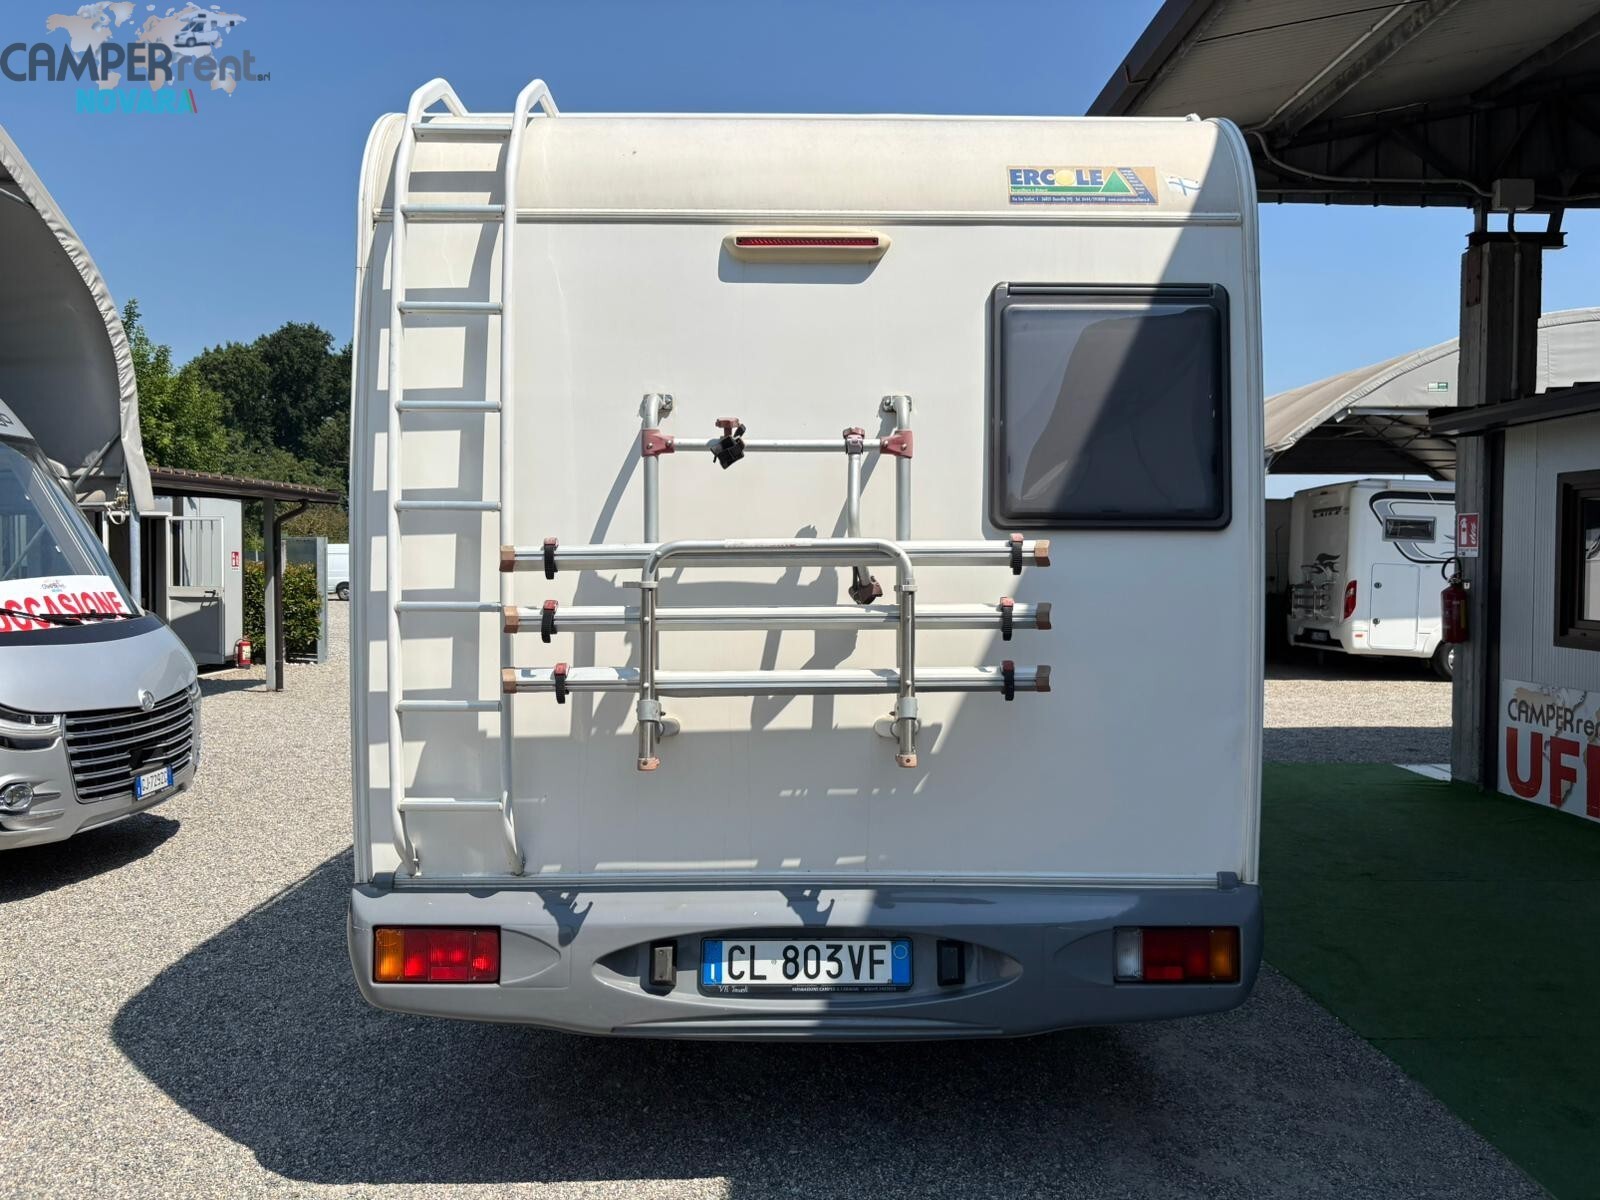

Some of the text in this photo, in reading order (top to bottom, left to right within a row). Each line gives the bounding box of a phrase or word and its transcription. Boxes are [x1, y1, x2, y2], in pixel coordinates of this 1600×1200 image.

[1009, 168, 1104, 186] ERCOLE
[727, 944, 767, 980] CL
[782, 944, 886, 980] 803VF
